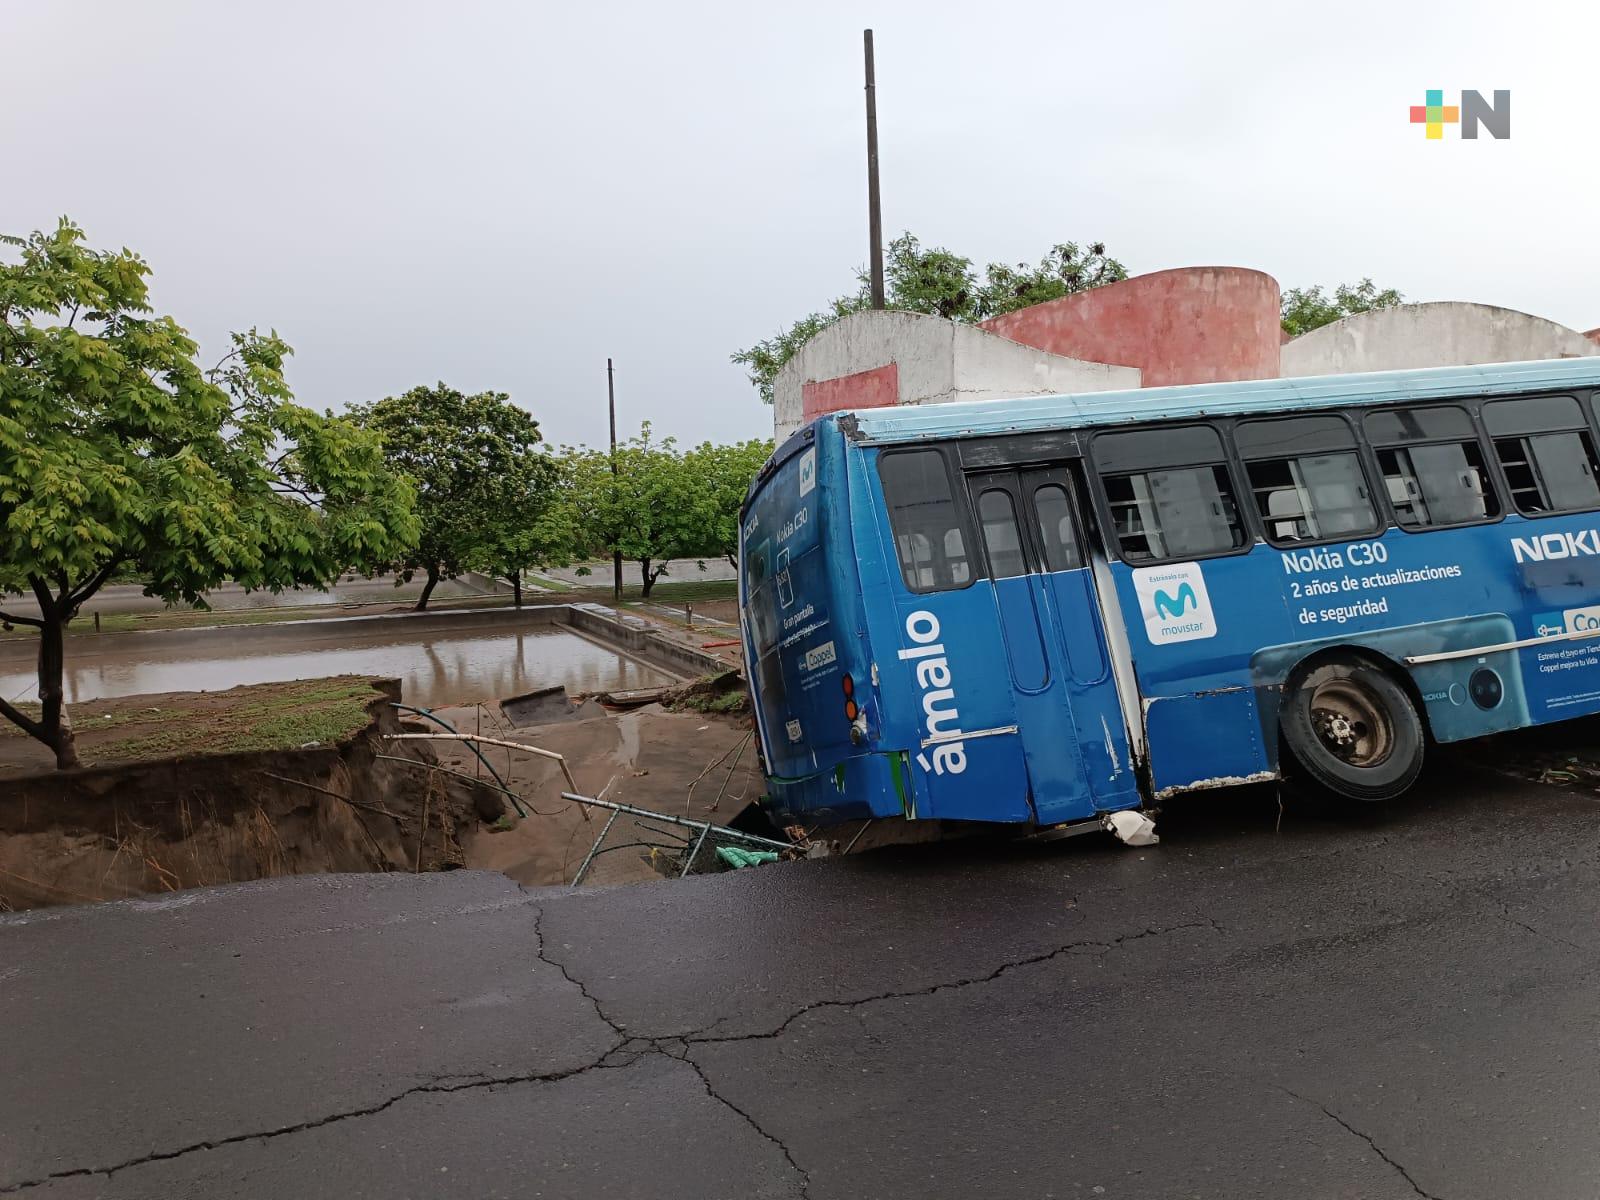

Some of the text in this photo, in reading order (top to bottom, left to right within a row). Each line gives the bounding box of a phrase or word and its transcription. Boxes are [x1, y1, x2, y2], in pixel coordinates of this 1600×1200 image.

[776, 507, 807, 546] Nokia C30
[1281, 541, 1388, 574] Nokia C30
[1291, 564, 1462, 598] 2 años de actualizaciones
[1299, 597, 1388, 624] de seguridad
[1161, 622, 1203, 636] movistar
[1540, 663, 1559, 673] Coppel
[1560, 661, 1578, 670] mejora
[897, 610, 967, 776] ámalo
